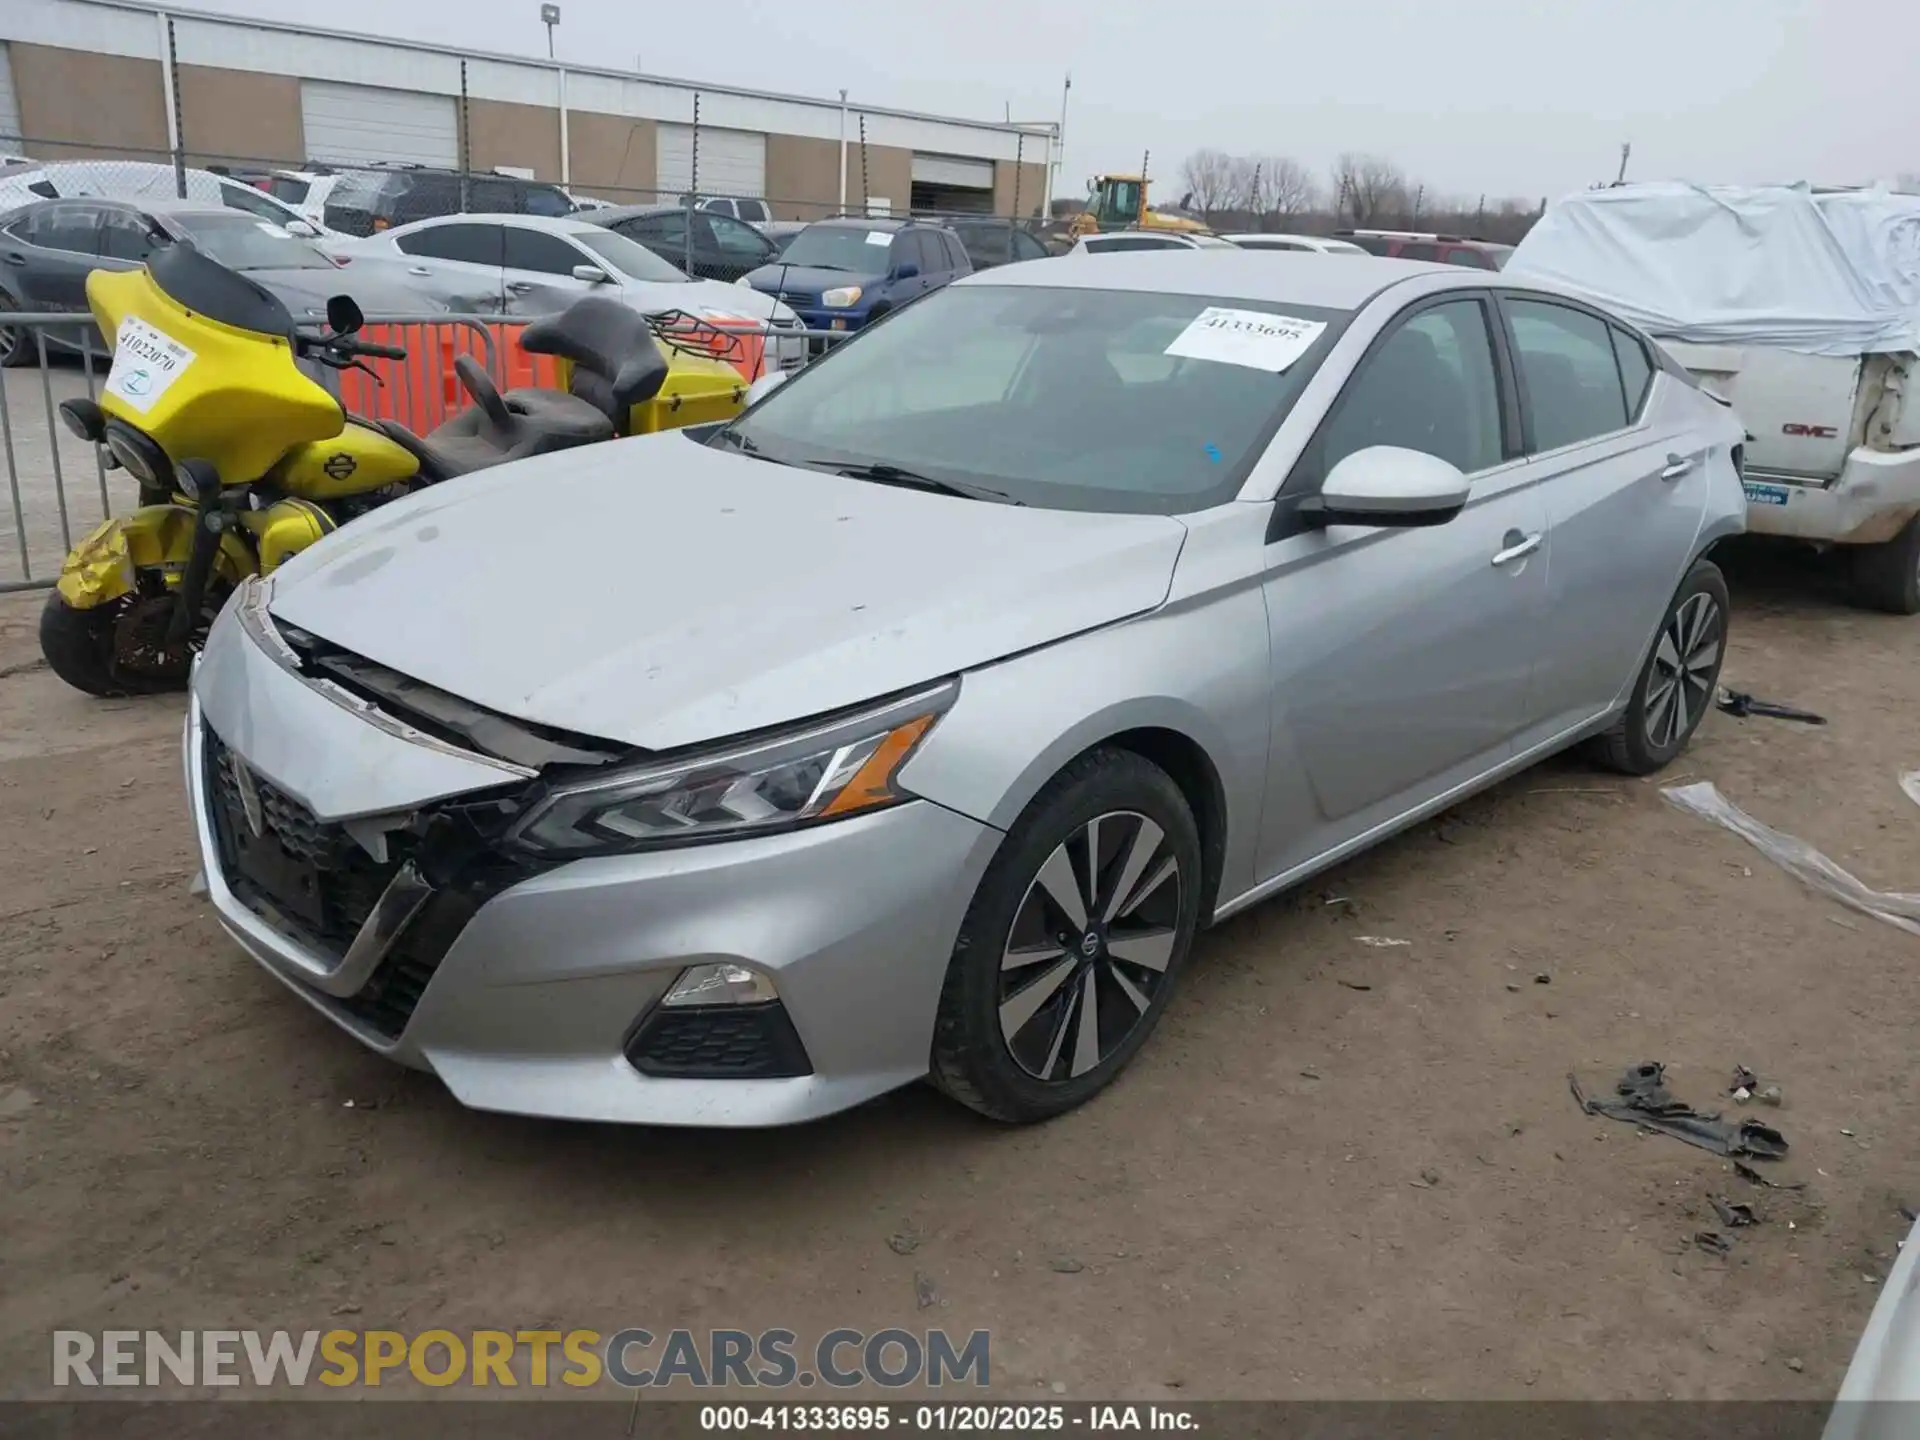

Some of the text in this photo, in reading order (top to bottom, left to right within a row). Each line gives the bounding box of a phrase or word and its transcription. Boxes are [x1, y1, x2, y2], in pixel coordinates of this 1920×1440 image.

[1206, 318, 1303, 341] 41333695
[120, 332, 176, 372] 41022070
[1782, 423, 1838, 439] GMC
